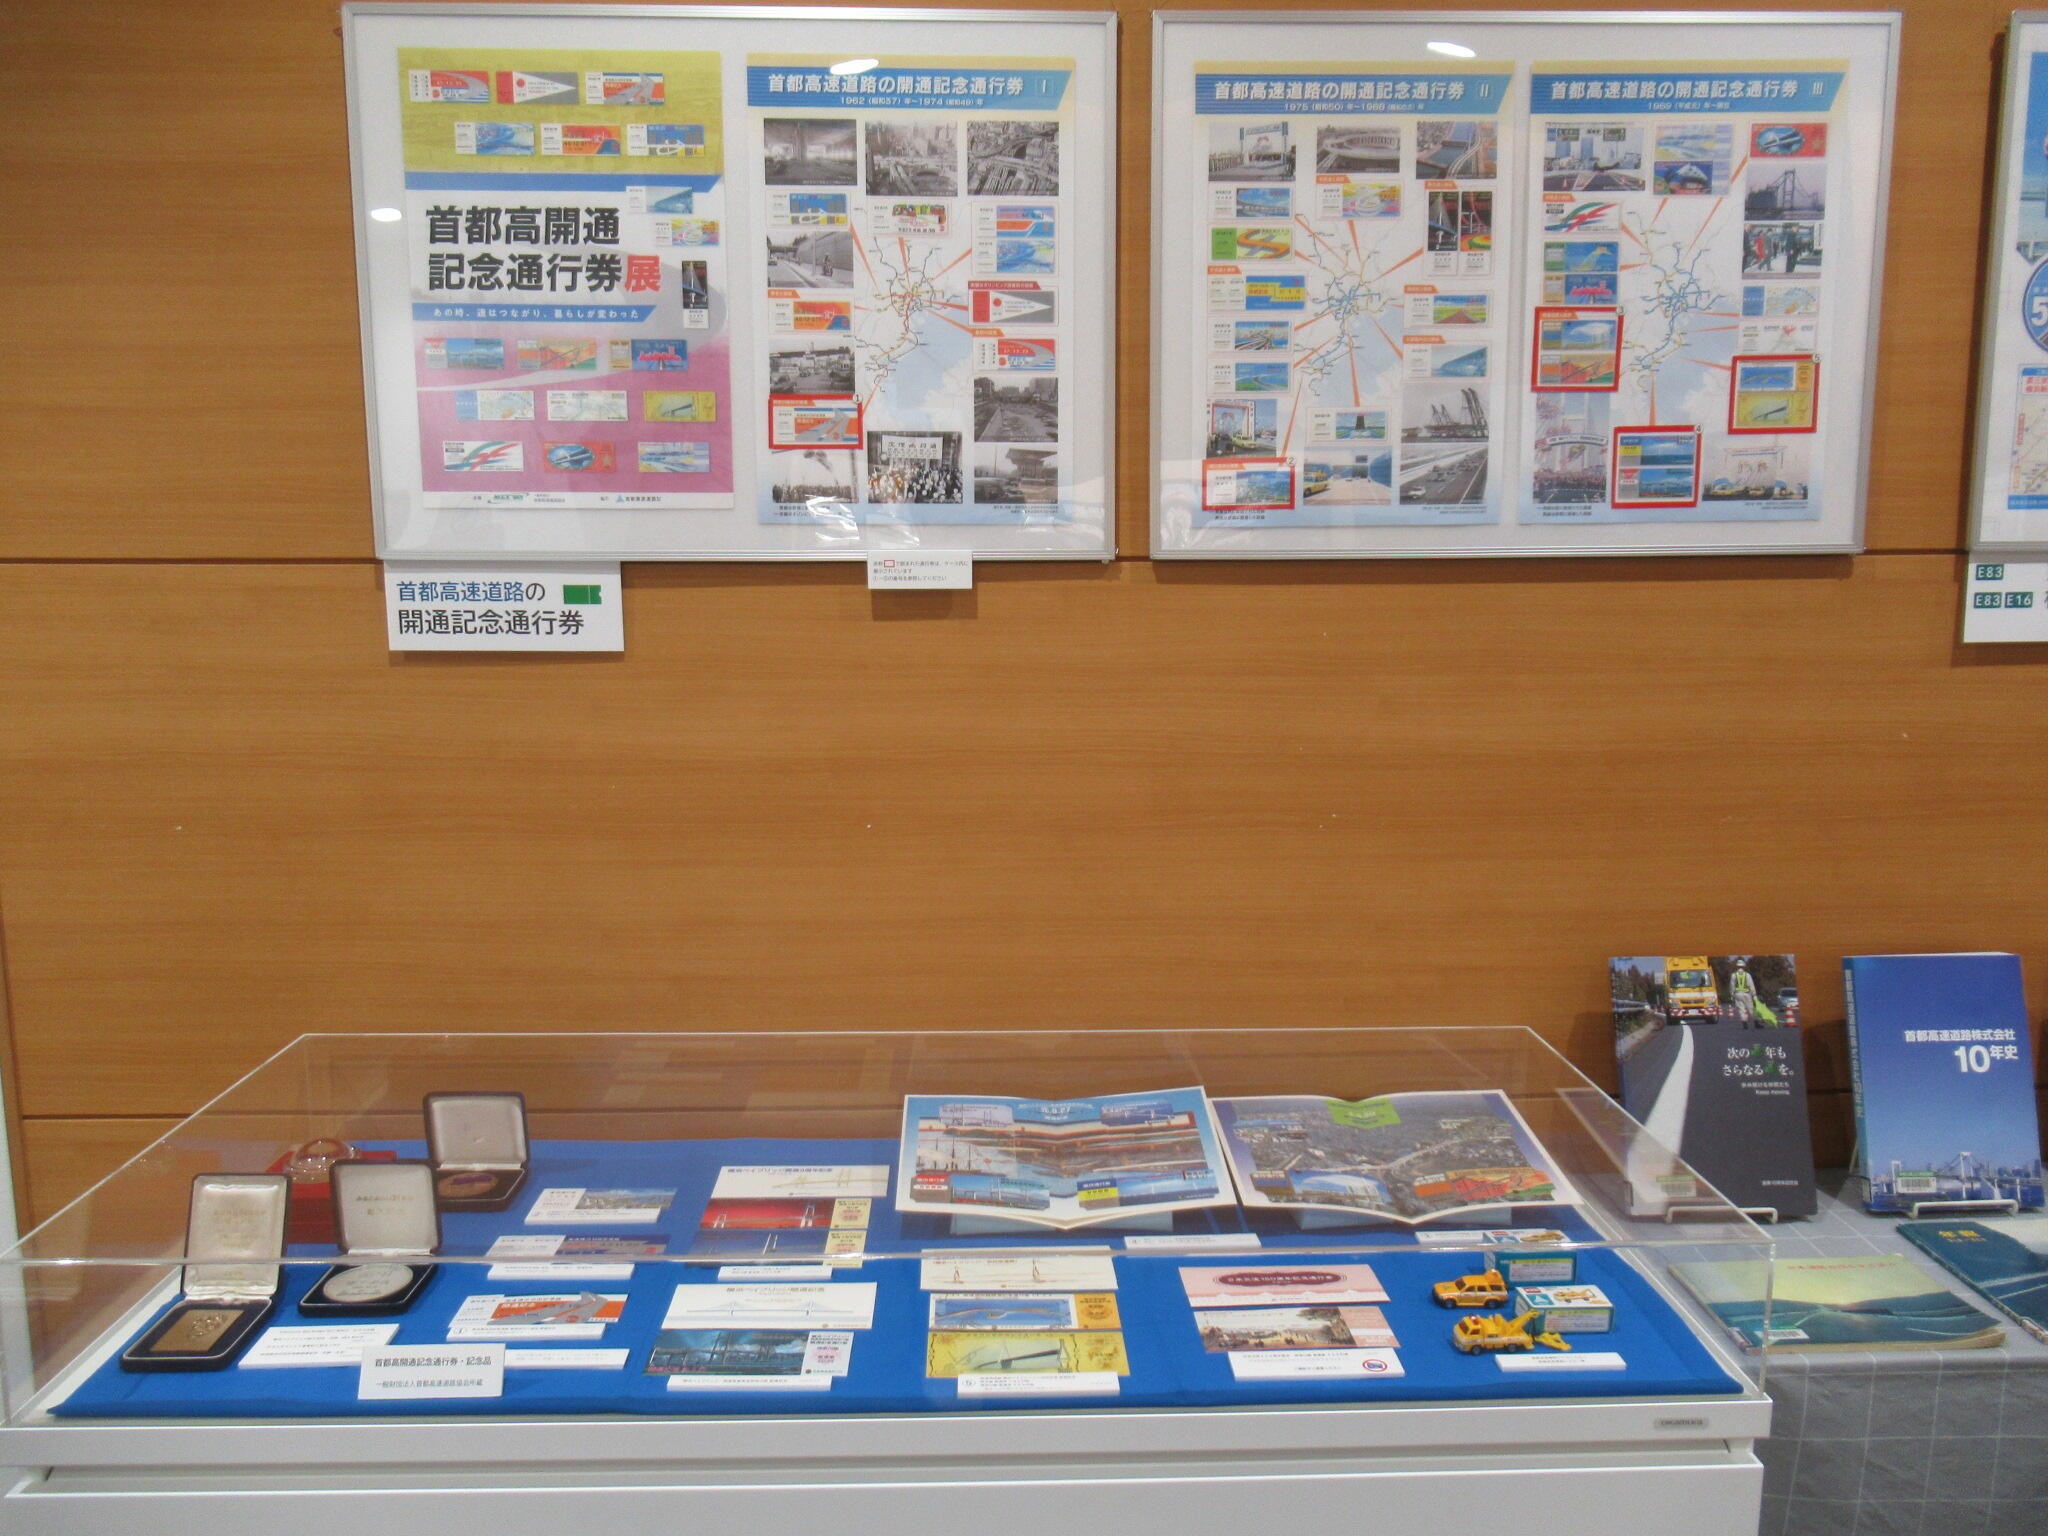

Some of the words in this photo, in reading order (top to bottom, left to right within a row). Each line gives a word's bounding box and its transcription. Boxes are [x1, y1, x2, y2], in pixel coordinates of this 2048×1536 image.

[768, 74, 1025, 96] 首都高速道路の開通記念通行券
[1214, 80, 1466, 101] 首都高速道路の開通記念通行券
[1550, 79, 1799, 101] 首都高速道路の開通記念通行券
[425, 205, 620, 246] 首都高開通
[428, 253, 662, 294] 記念通行券展
[1977, 566, 2003, 578] E83
[396, 581, 546, 603] 首都高速道路の
[1975, 594, 2001, 606] E83
[2006, 594, 2032, 606] E16
[398, 609, 584, 636] 開通記念通行券
[1903, 1028, 2017, 1043] 首都高速道路株式会社
[1953, 1044, 2019, 1074] 10年史
[374, 1356, 492, 1368] 首都高開通記念通行券・記念品
